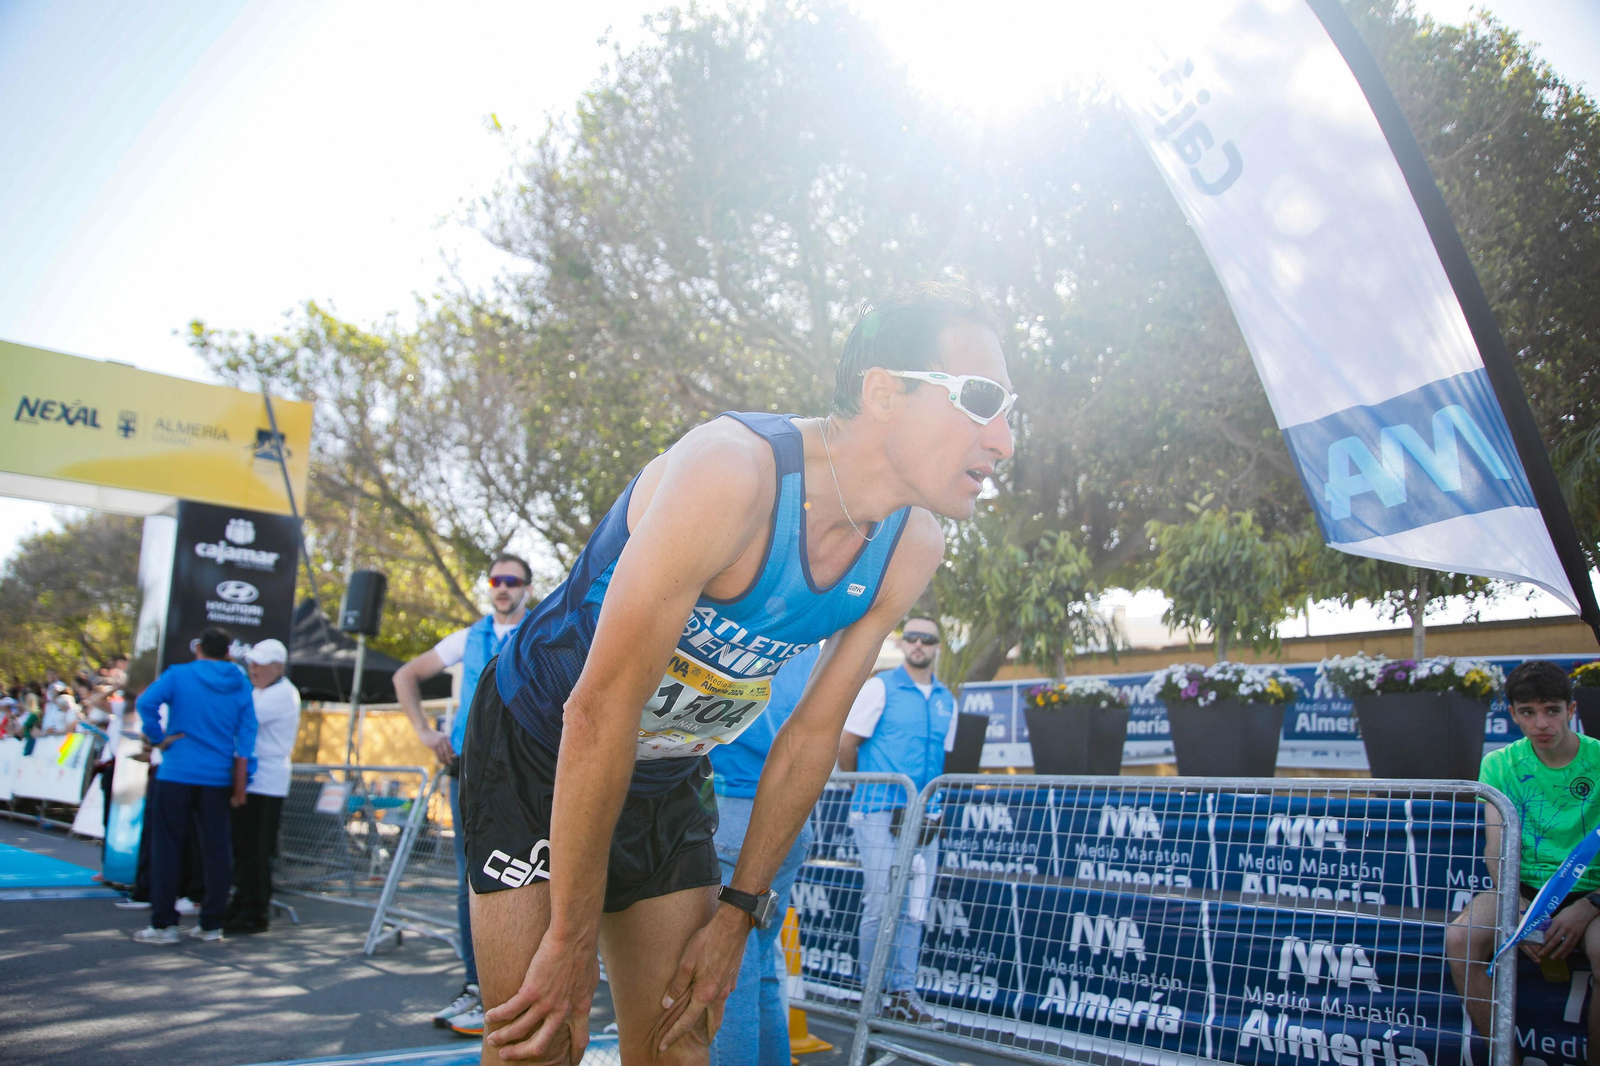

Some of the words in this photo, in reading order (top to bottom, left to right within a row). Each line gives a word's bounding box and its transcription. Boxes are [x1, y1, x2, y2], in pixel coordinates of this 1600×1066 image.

[14, 395, 101, 428] NEXAL
[194, 539, 281, 565] cajamar
[652, 681, 758, 729] 1504
[1294, 711, 1358, 733] Almer
[1074, 842, 1120, 859] Medio
[1124, 845, 1191, 865] Maratón
[1238, 852, 1293, 872] Medio
[1300, 856, 1384, 880] Maratón
[915, 964, 999, 1001] mería
[1042, 954, 1096, 979] Medio
[1038, 976, 1183, 1034] Almería
[1243, 983, 1310, 1012] Medio
[1320, 995, 1427, 1031] Maratón
[1514, 1025, 1588, 1061] Medi
